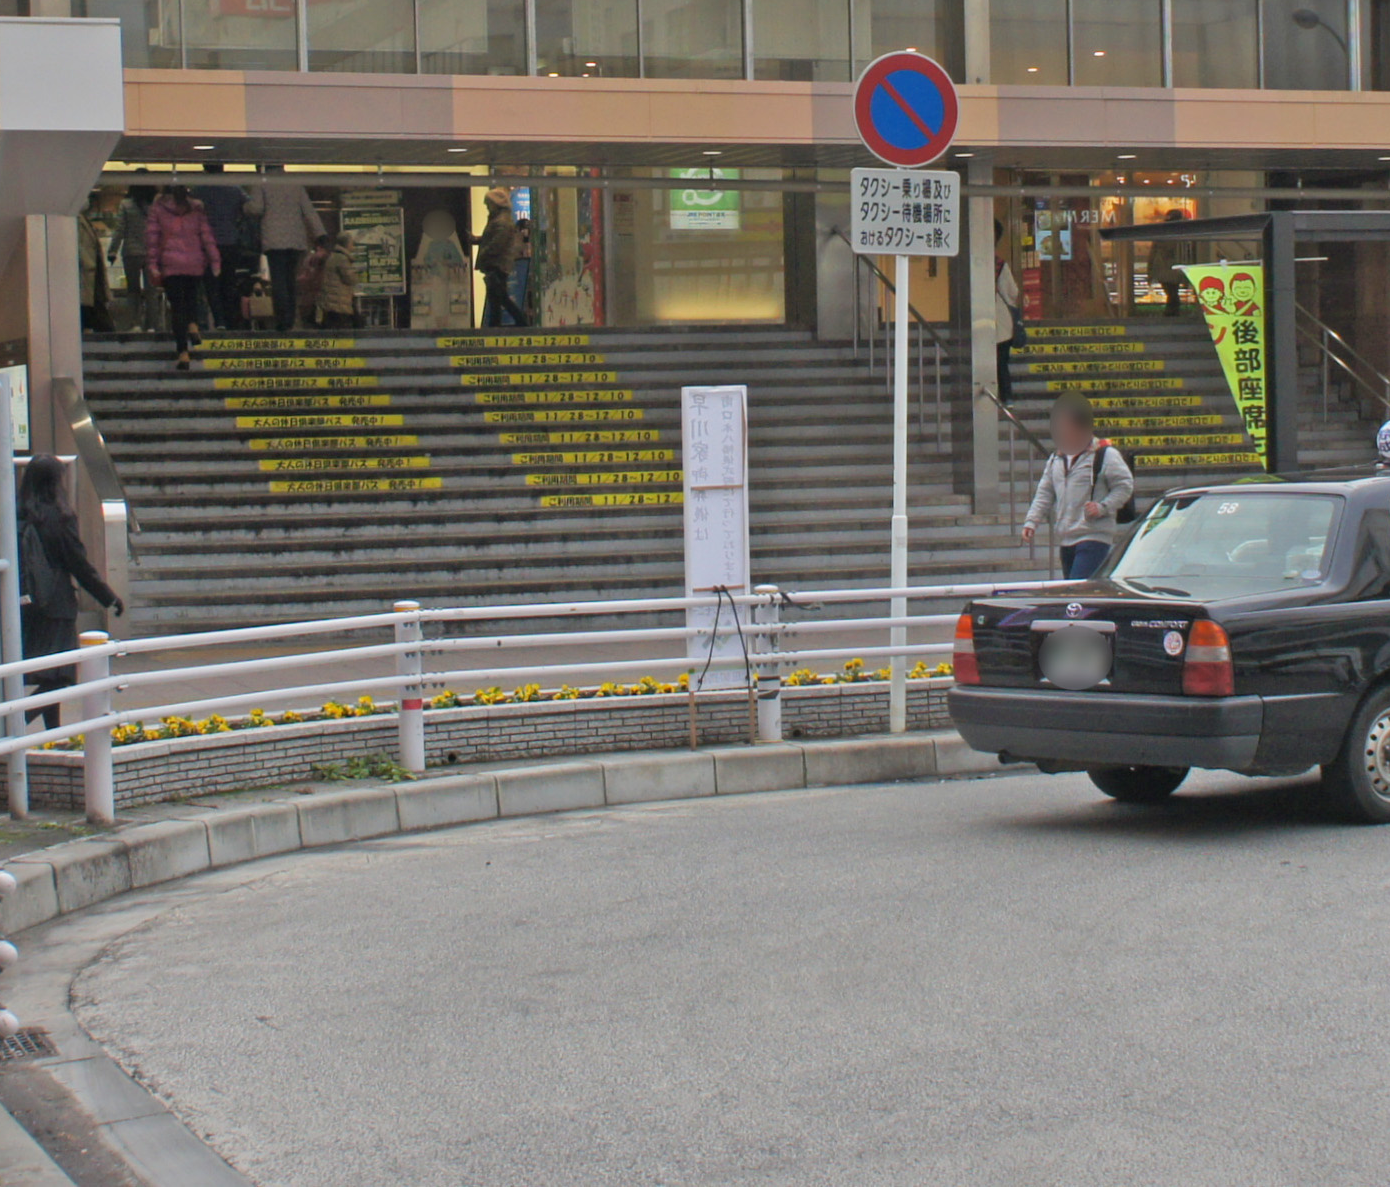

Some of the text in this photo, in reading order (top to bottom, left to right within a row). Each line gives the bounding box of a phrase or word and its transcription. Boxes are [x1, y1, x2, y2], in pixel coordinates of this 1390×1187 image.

[860, 177, 952, 200] タクシー乗り場及び
[860, 201, 952, 224] タクシー待機場所に
[860, 226, 951, 249] おけるタクシーを除く
[604, 494, 682, 504] 11/28～12/
[1217, 502, 1239, 515] 58
